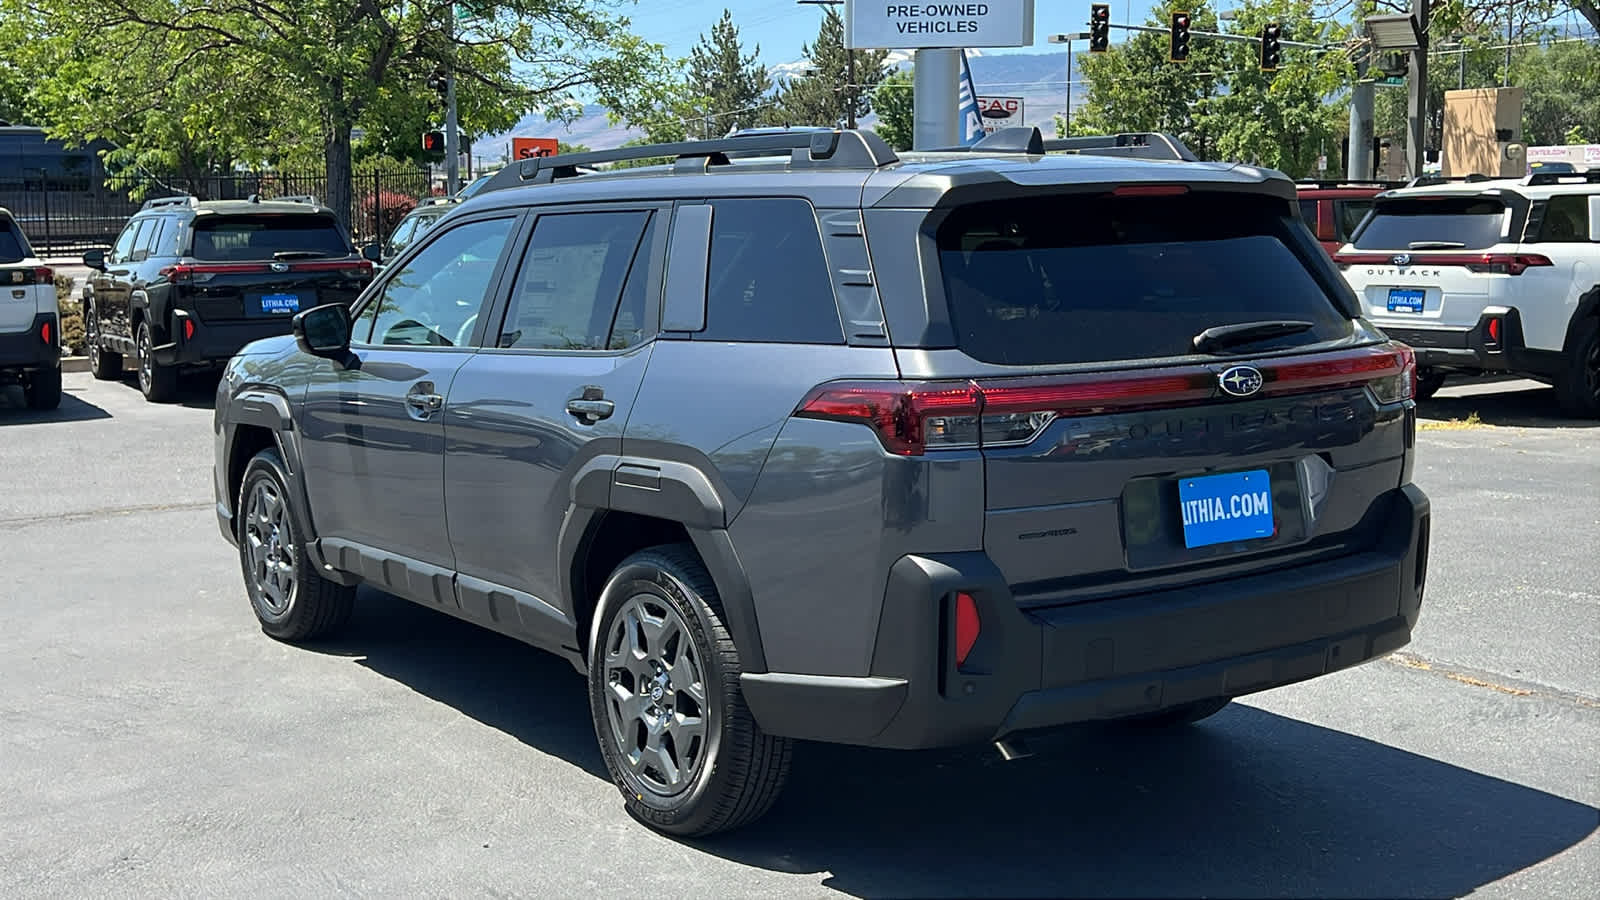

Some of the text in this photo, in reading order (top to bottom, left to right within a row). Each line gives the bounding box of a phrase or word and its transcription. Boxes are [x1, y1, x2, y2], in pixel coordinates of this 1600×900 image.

[887, 4, 989, 17] PRE-OWNED
[896, 20, 978, 33] VEHICLES
[262, 299, 299, 308] LITHIA.COM
[1389, 296, 1423, 305] LITHIA.COM
[1181, 491, 1269, 526] LITHIA.COM
